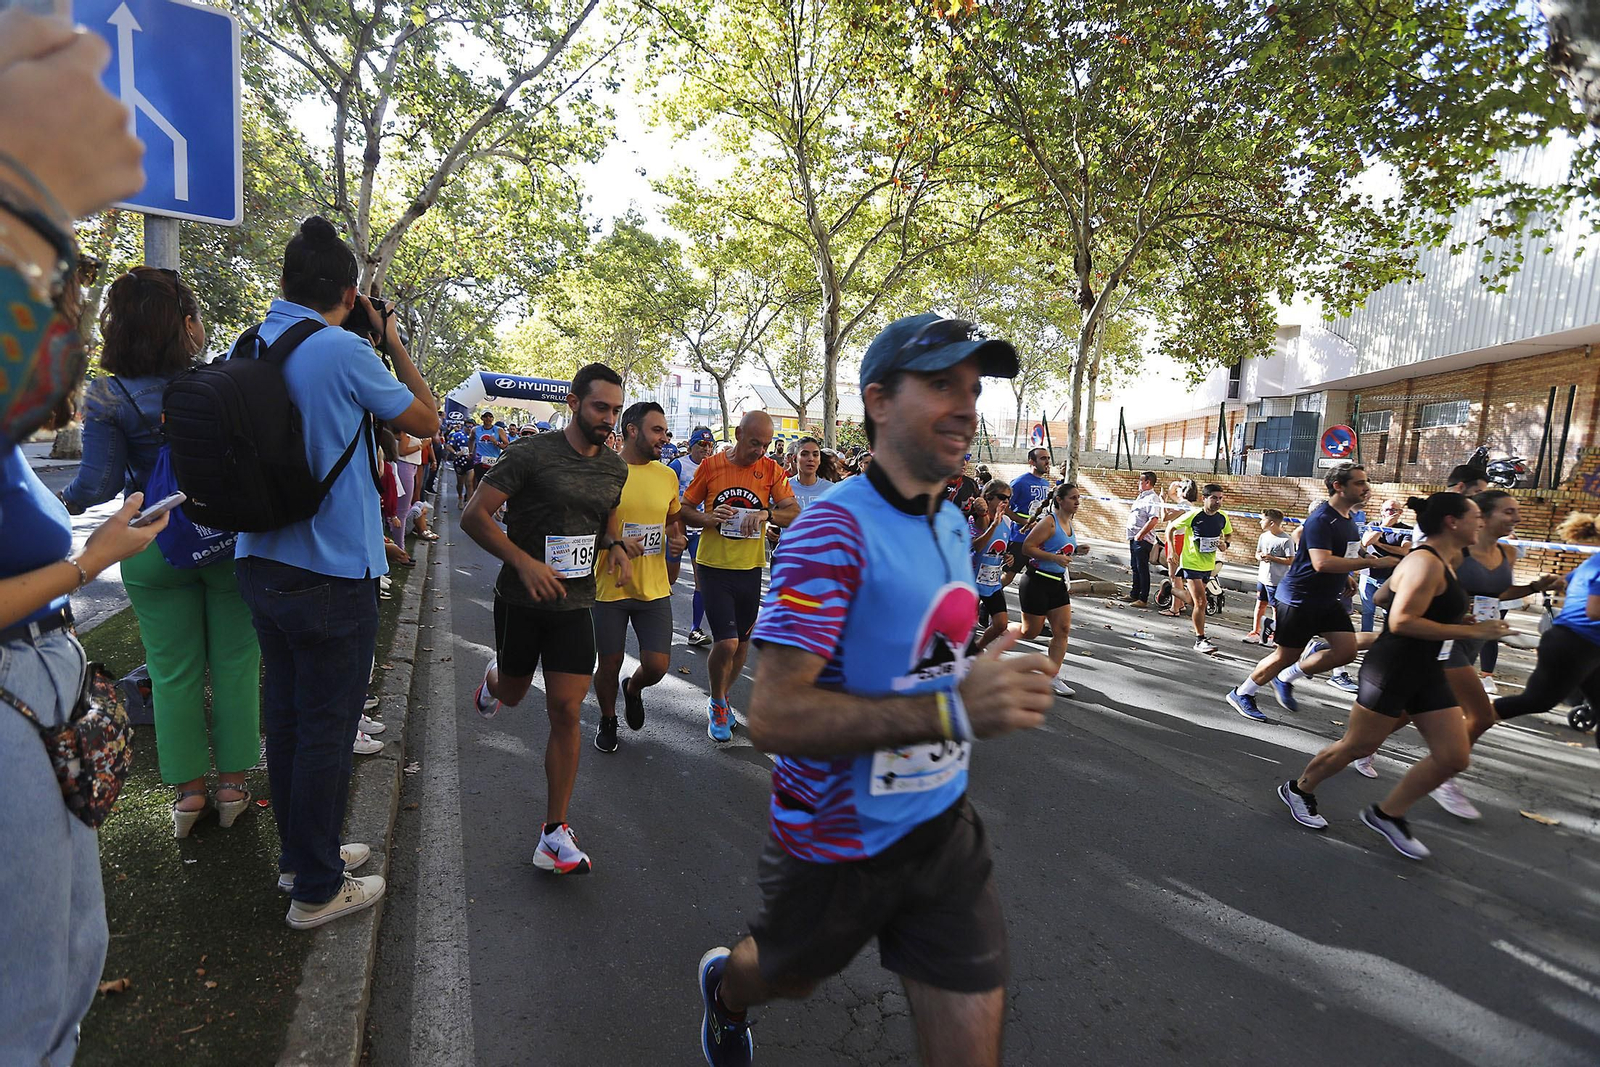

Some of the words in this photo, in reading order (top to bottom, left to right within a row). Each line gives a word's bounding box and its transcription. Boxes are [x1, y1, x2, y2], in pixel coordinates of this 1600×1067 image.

[519, 381, 569, 393] HYUNDAI
[717, 488, 759, 505] SPARTAN
[643, 531, 661, 547] 152
[571, 546, 594, 566] 195
